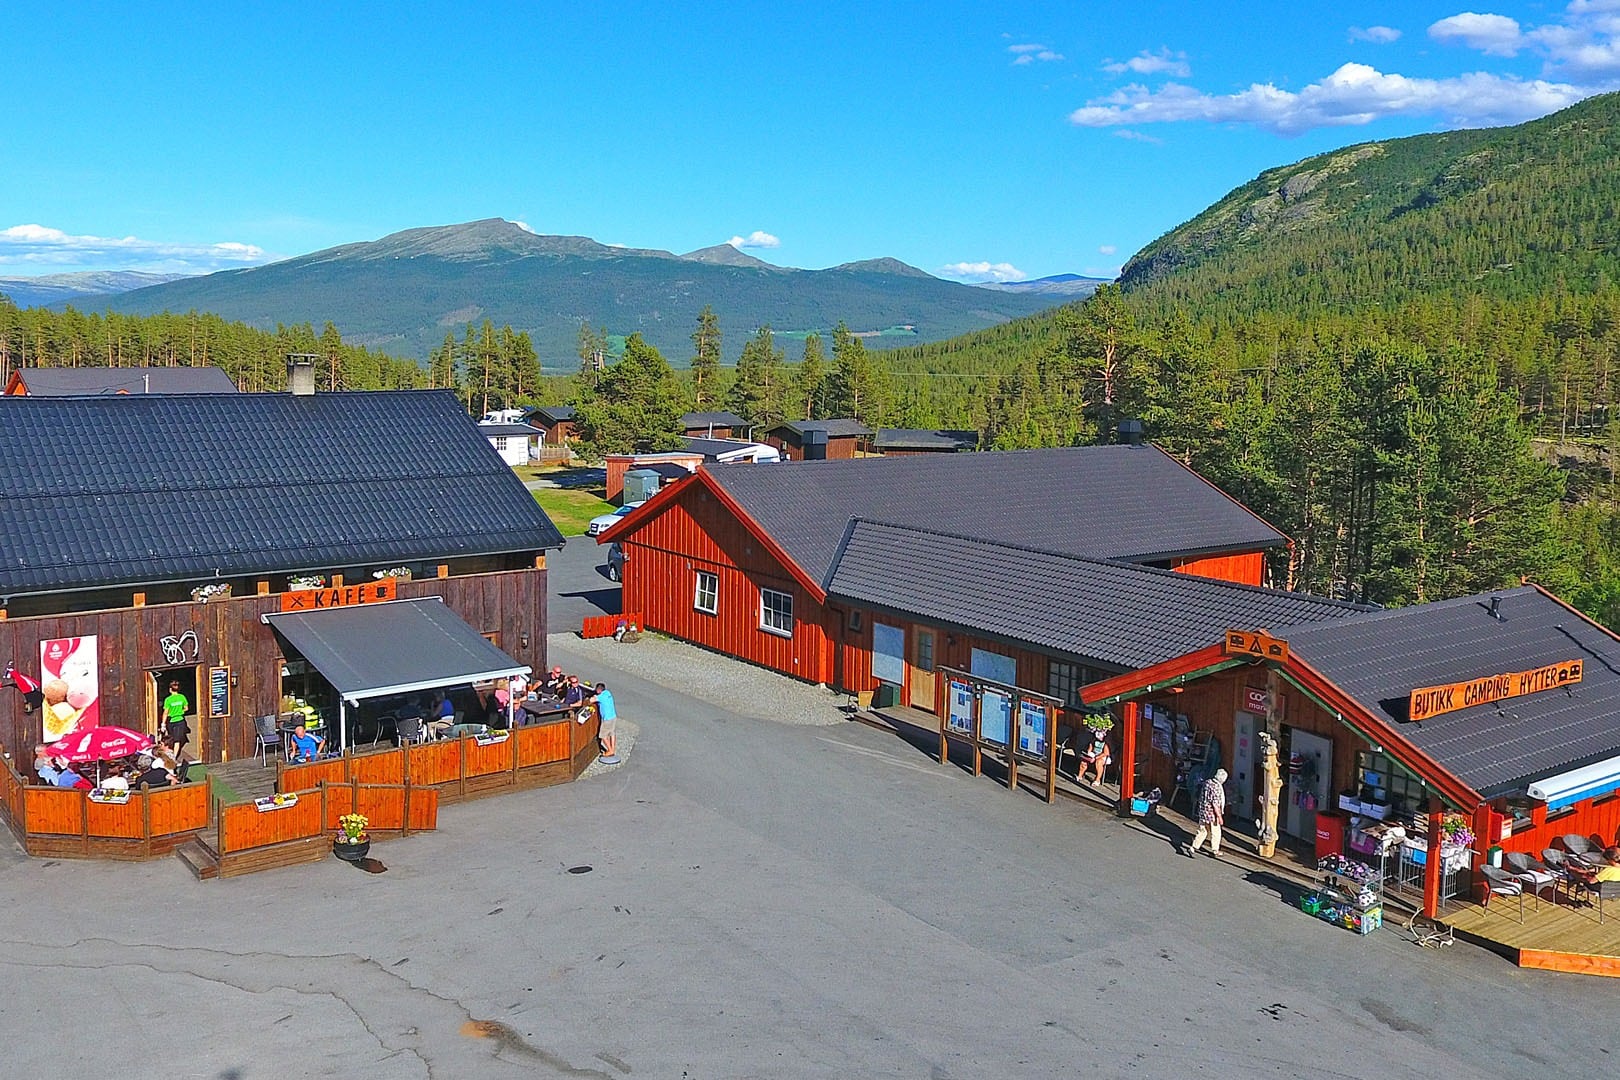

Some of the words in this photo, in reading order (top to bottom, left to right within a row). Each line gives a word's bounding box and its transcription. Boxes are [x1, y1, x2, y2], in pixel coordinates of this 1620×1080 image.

[1414, 687, 1455, 715] BUTIKK
[1464, 676, 1510, 706] CAMPING
[1520, 666, 1558, 694] HYTTER
